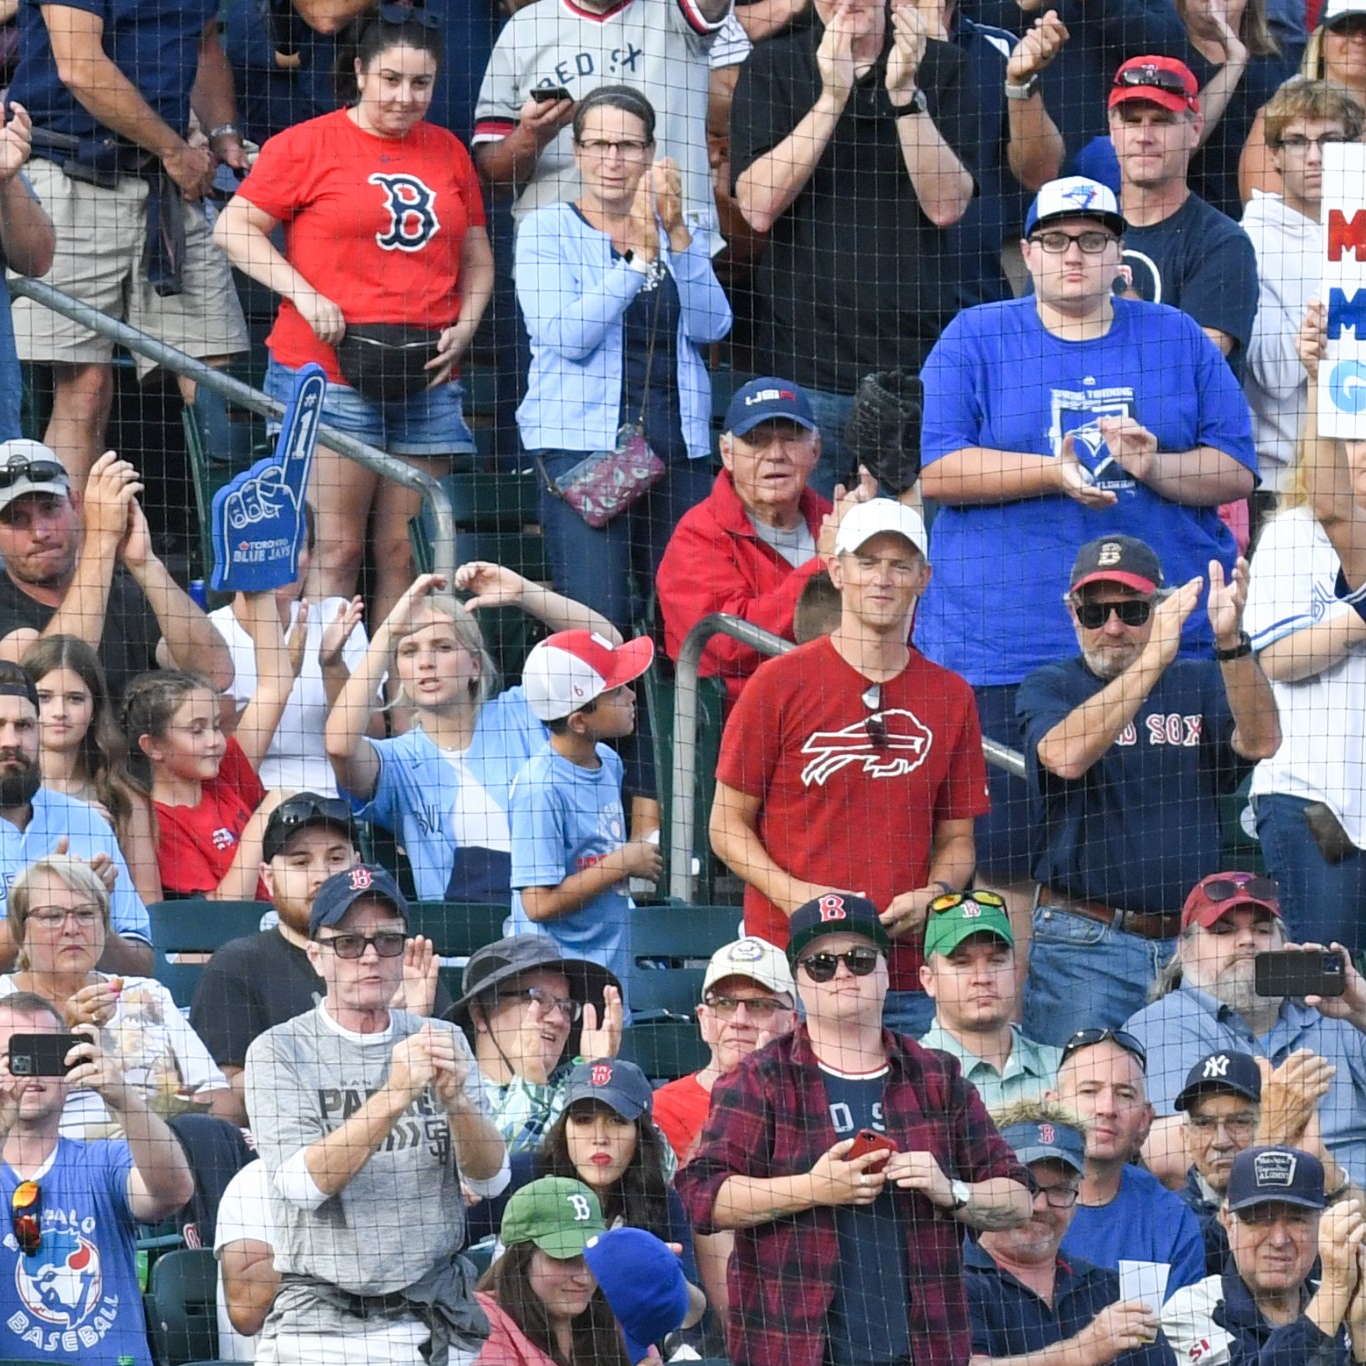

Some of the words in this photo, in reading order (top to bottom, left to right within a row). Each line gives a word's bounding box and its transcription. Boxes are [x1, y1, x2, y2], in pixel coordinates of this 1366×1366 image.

[369, 173, 441, 252] B
[233, 550, 265, 563] BLUE
[1147, 714, 1205, 746] SOX
[817, 893, 847, 923] B
[1202, 1055, 1229, 1078] NY
[566, 1193, 591, 1221] B
[7, 1293, 118, 1351] BASEBALL
